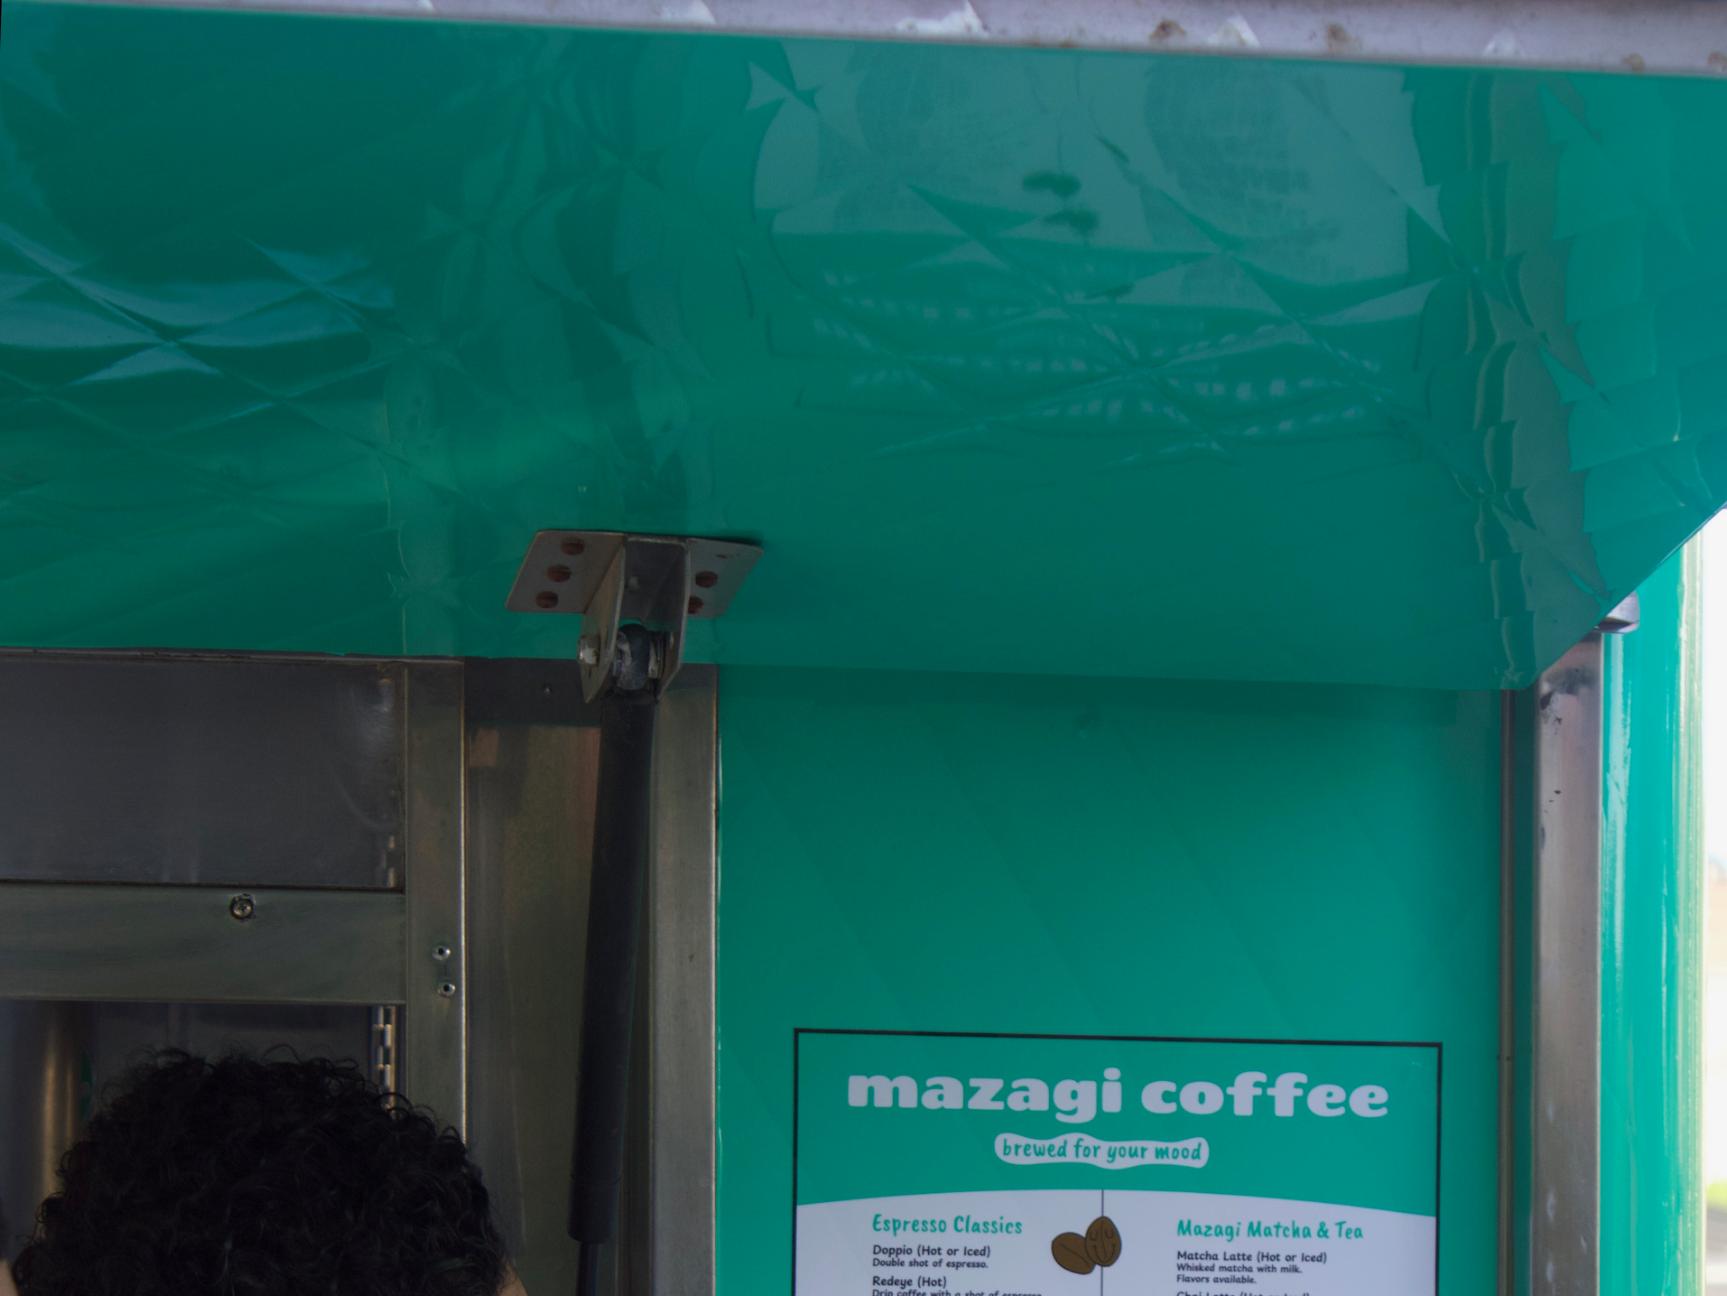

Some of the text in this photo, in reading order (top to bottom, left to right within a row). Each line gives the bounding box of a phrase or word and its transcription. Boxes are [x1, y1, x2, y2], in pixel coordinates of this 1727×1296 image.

[848, 1067, 1389, 1123] mazagi coffee
[1003, 1138, 1202, 1163] brewed for your mood
[872, 1214, 1023, 1237] Espresso Classics
[1177, 1219, 1363, 1241] Mazagi Matcha & Tea
[872, 1245, 991, 1258] Doppio (Hot or Iced)
[1177, 1250, 1327, 1264] Matcha Latte (Hot or Iced)
[872, 1258, 988, 1271] Double shot of espresso.
[1176, 1262, 1302, 1273] Whisked matcha with milk.
[872, 1276, 947, 1289] Redeye (Hot)
[1176, 1274, 1256, 1283] Flavors available.
